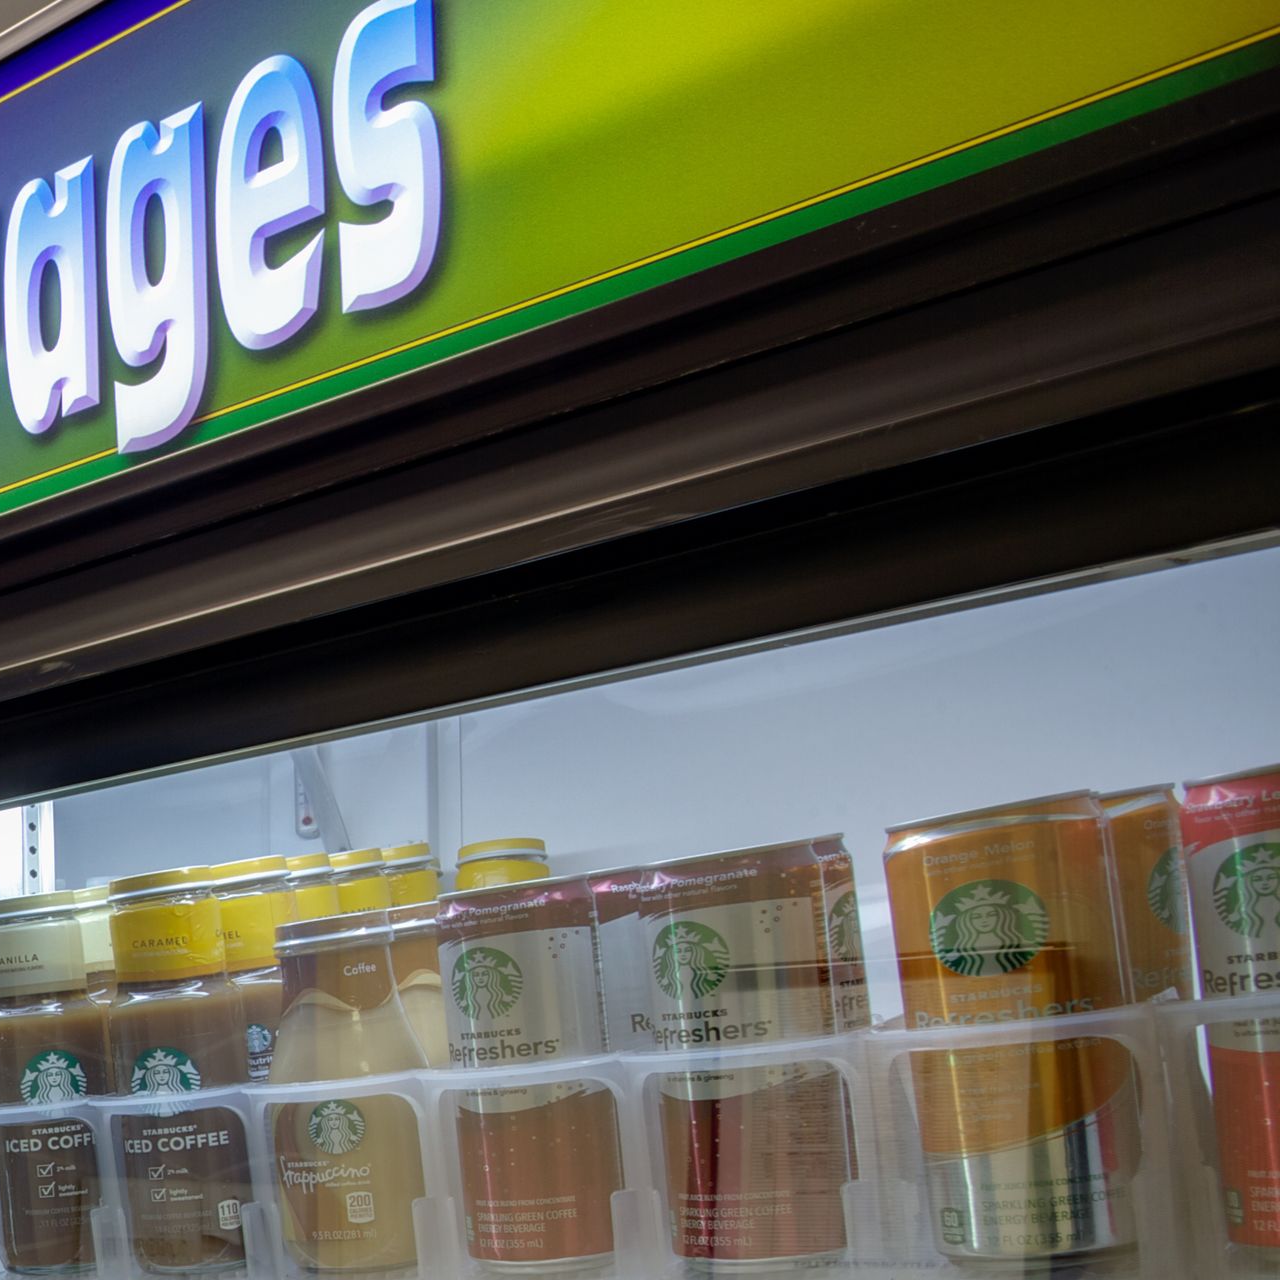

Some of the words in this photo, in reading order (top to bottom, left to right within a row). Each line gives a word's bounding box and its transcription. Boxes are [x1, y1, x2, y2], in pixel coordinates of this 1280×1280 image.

[922, 851, 978, 868] Orange
[983, 839, 1035, 856] Melon
[670, 867, 758, 888] Pomegranate
[469, 898, 546, 916] Pomegranate
[132, 935, 189, 950] CARAMEL
[343, 962, 377, 977] Coffee
[662, 1008, 728, 1022] STARBUCKS
[914, 996, 1094, 1030] Refreshers
[461, 1028, 521, 1040] STARBUCKS
[449, 1038, 558, 1068] Refreshers
[31, 1124, 84, 1136] STARBUCKS
[142, 1125, 197, 1136] STARBUCKS
[6, 1139, 43, 1153] ICED
[125, 1139, 153, 1153] ICED
[157, 1130, 230, 1152] COFFEE
[349, 1194, 371, 1207] 200
[1049, 1192, 1090, 1207] GREEN
[219, 1202, 237, 1214] 110
[514, 1210, 544, 1221] GREEN
[546, 1208, 577, 1220] COFFEE
[720, 1206, 753, 1217] GREEN
[983, 1212, 1029, 1227] ENERGY
[504, 1222, 546, 1233] BEVERAGE
